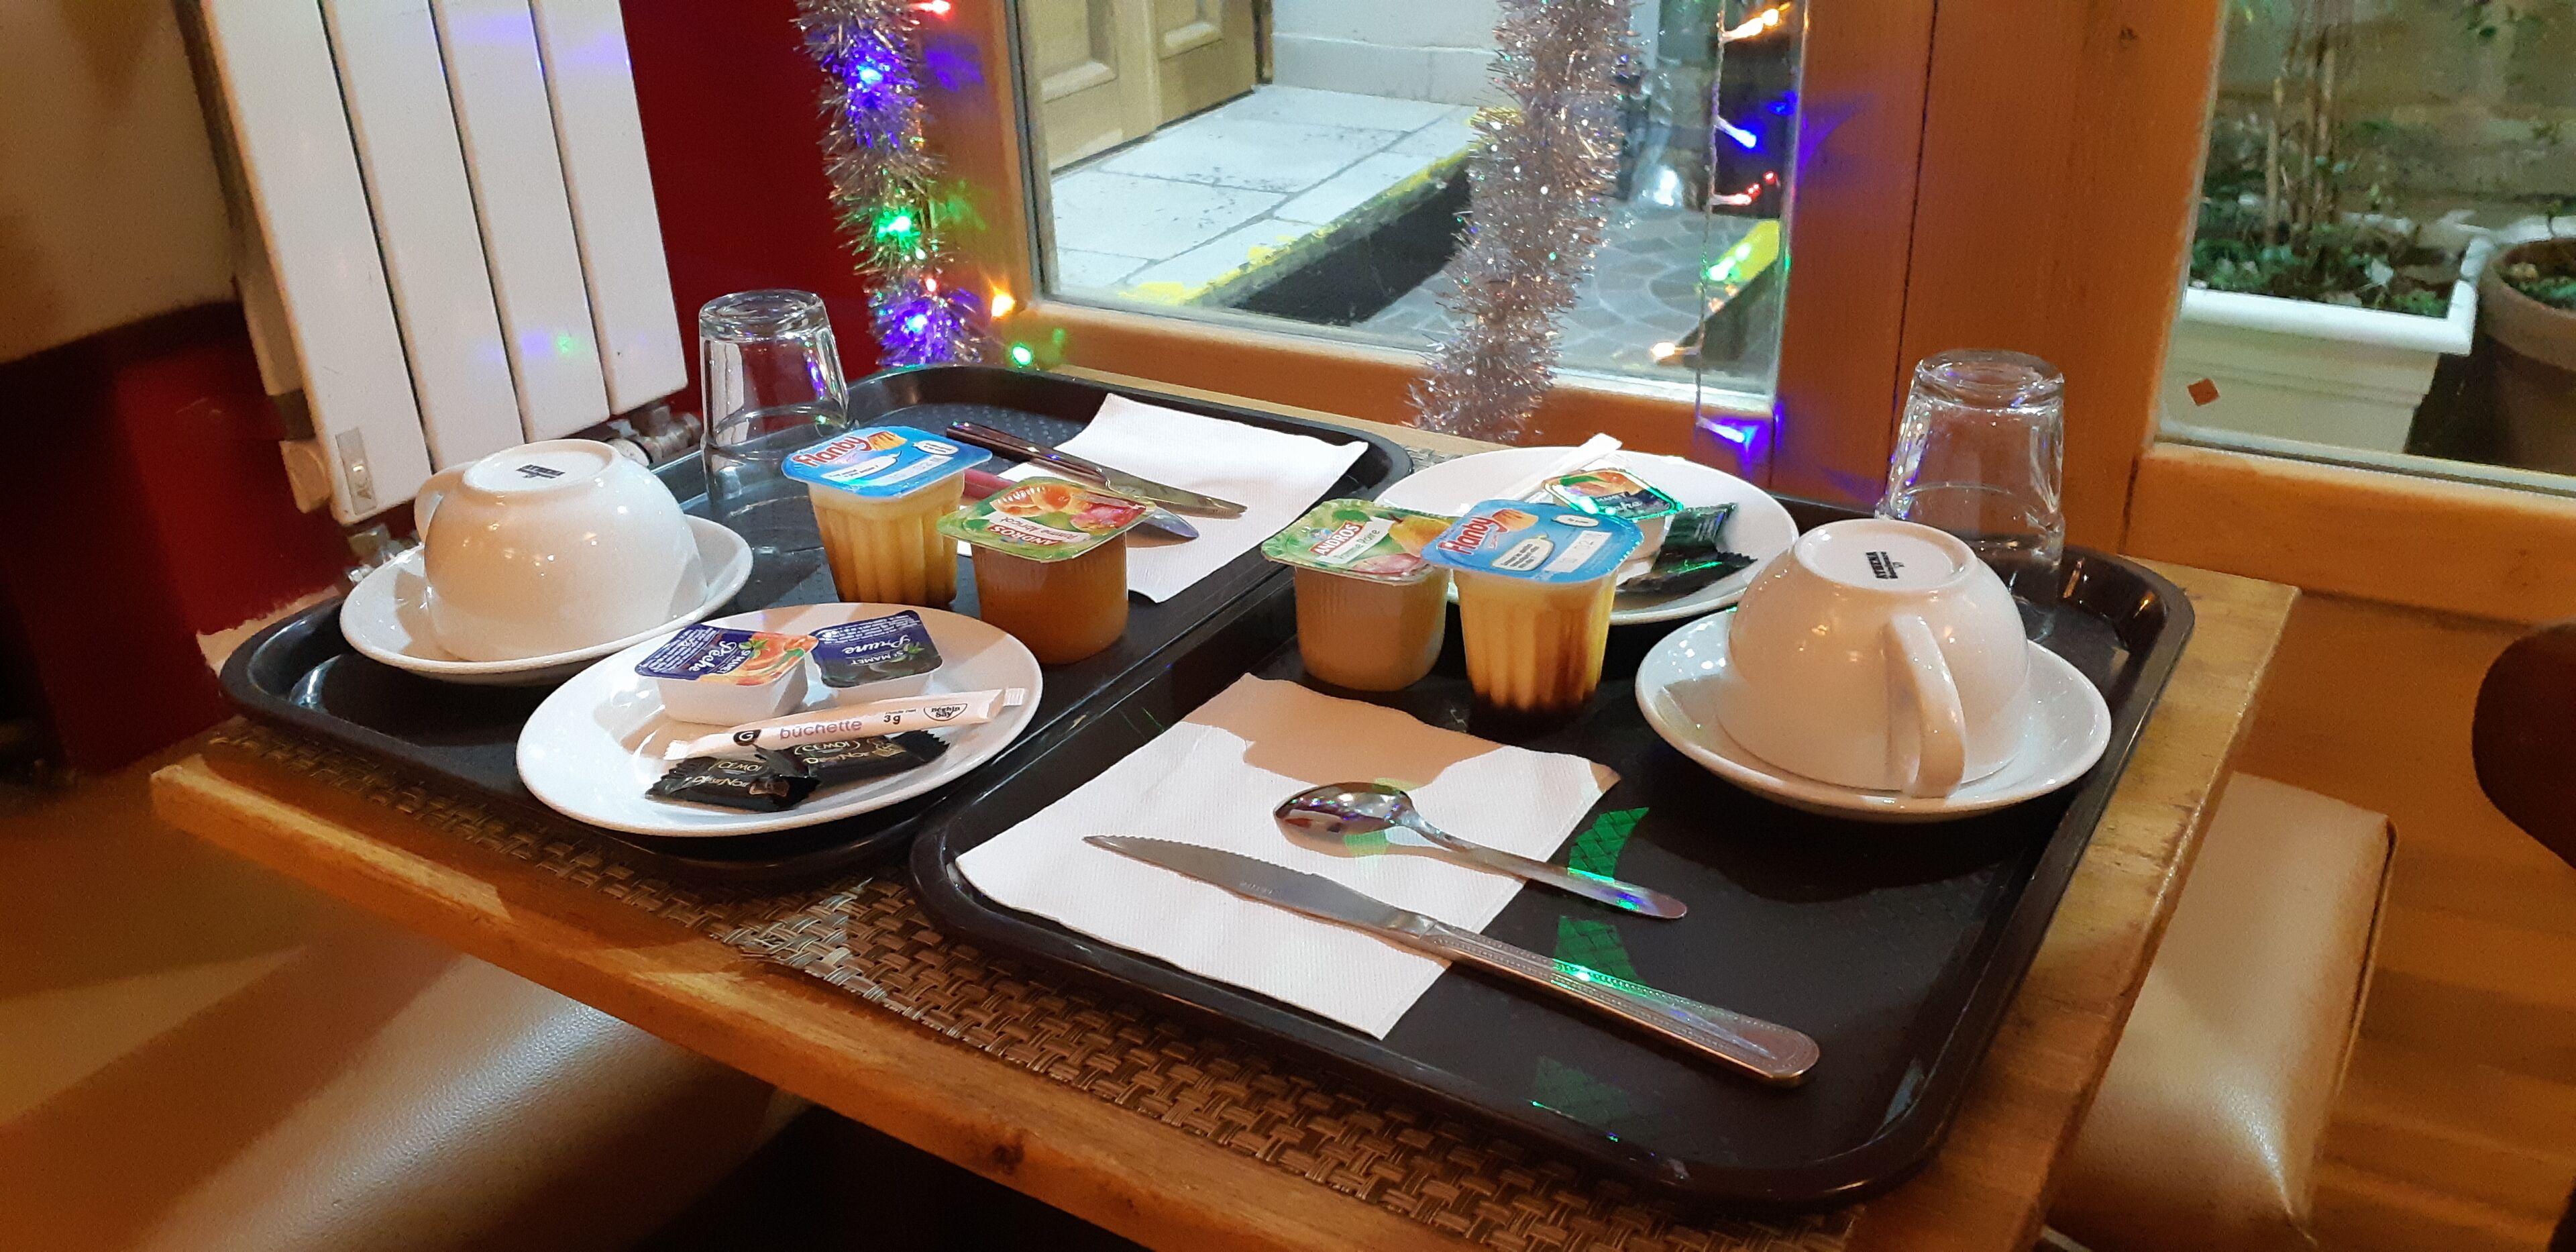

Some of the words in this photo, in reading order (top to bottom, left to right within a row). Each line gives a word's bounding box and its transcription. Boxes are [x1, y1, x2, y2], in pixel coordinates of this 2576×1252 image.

[989, 525, 1057, 545] ANDROS
[1315, 523, 1361, 555] ANDROS
[842, 634, 910, 655] Prune
[851, 654, 892, 666] MAMET
[779, 719, 863, 739] bûchette
